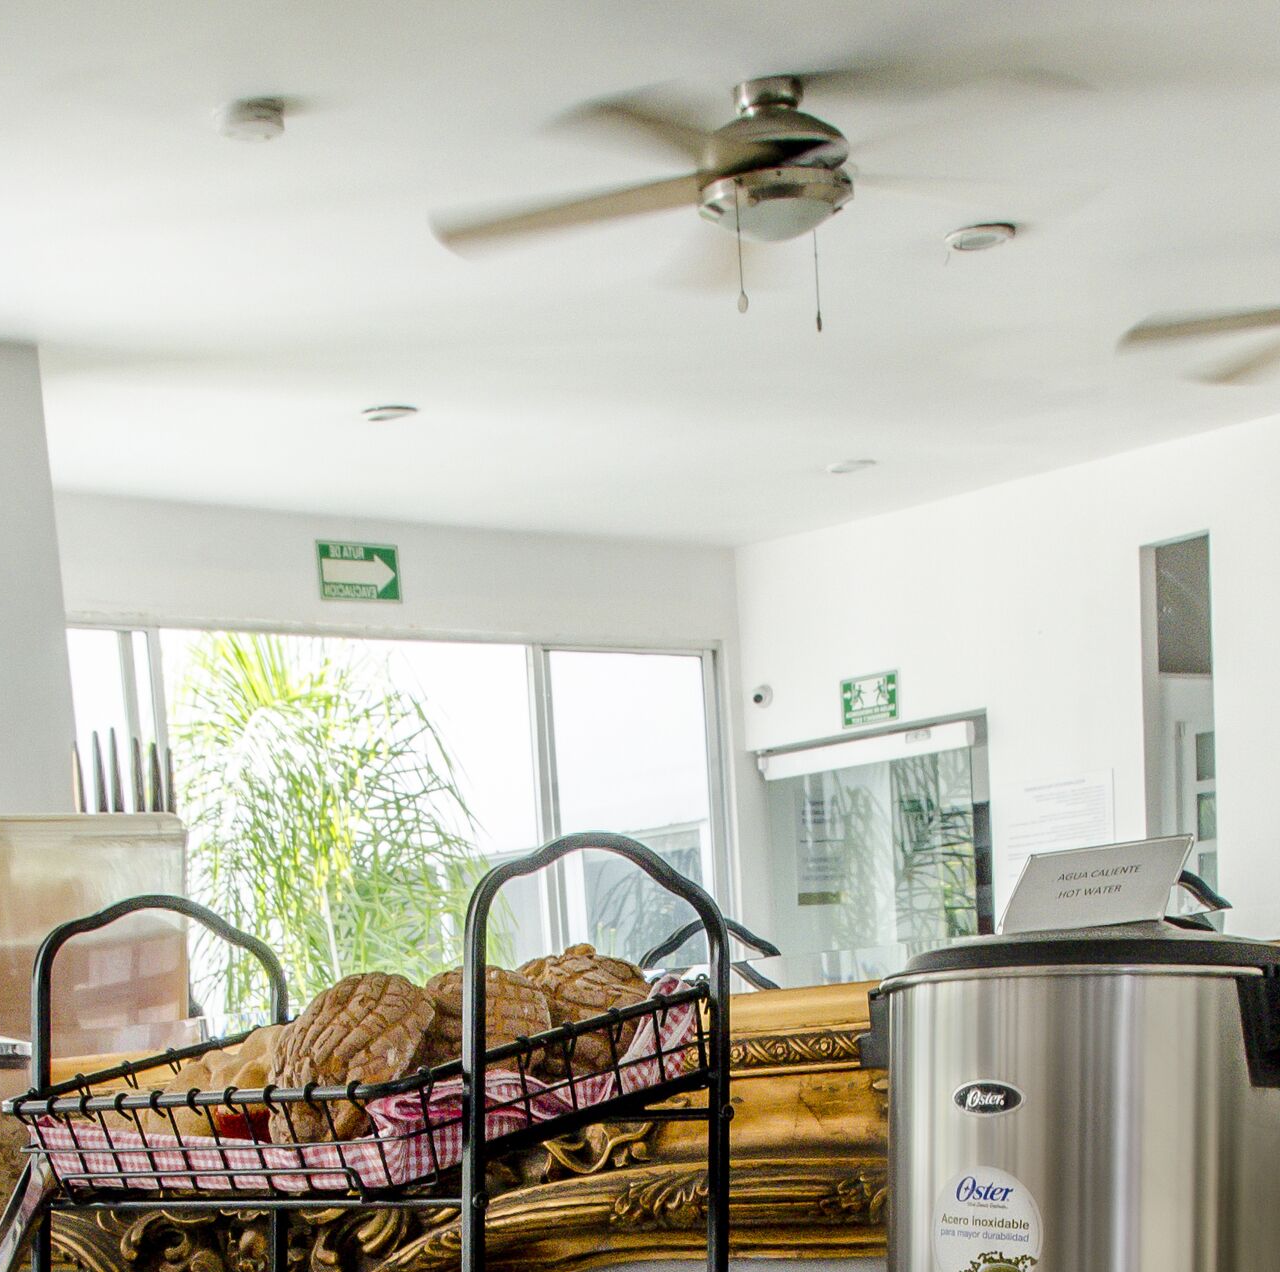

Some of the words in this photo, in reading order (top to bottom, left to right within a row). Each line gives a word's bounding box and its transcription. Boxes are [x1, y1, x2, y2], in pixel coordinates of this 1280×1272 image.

[1056, 872, 1089, 883] AGUA
[1090, 863, 1143, 879] CALIENTE
[1058, 888, 1082, 900] HOT
[1083, 884, 1123, 898] WATER
[968, 1089, 1005, 1107] Oster
[955, 1176, 1014, 1202] Oster
[941, 1213, 969, 1226] Acero
[971, 1215, 1030, 1231] inoxidable
[940, 1228, 956, 1238] para
[957, 1229, 980, 1241] mayor
[982, 1230, 1030, 1244] durabilidad
